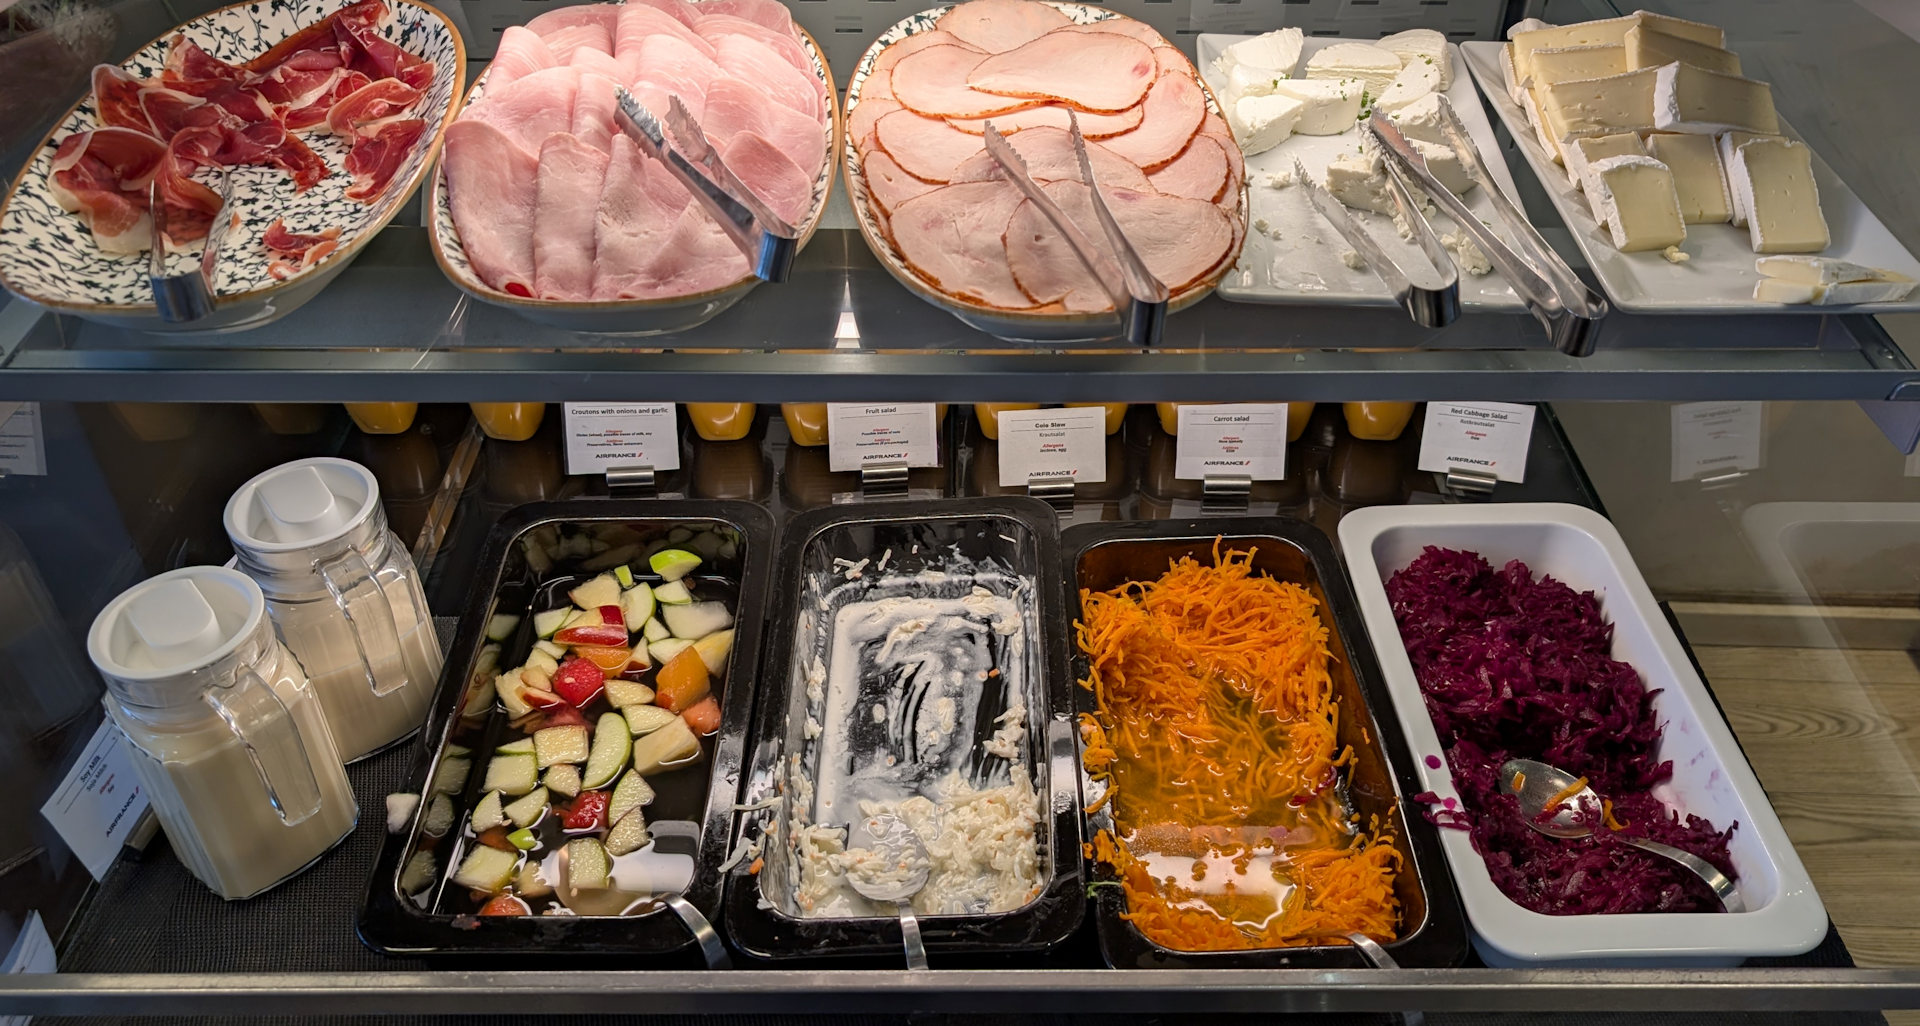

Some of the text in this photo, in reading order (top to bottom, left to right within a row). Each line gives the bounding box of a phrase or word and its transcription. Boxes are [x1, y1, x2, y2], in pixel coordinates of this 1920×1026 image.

[652, 407, 668, 415] garlic
[1464, 410, 1490, 418] Cabbage
[1446, 456, 1489, 466] AIRFRANCE
[80, 755, 101, 782] Soy Milk
[106, 793, 136, 838] AIRFRANCE
